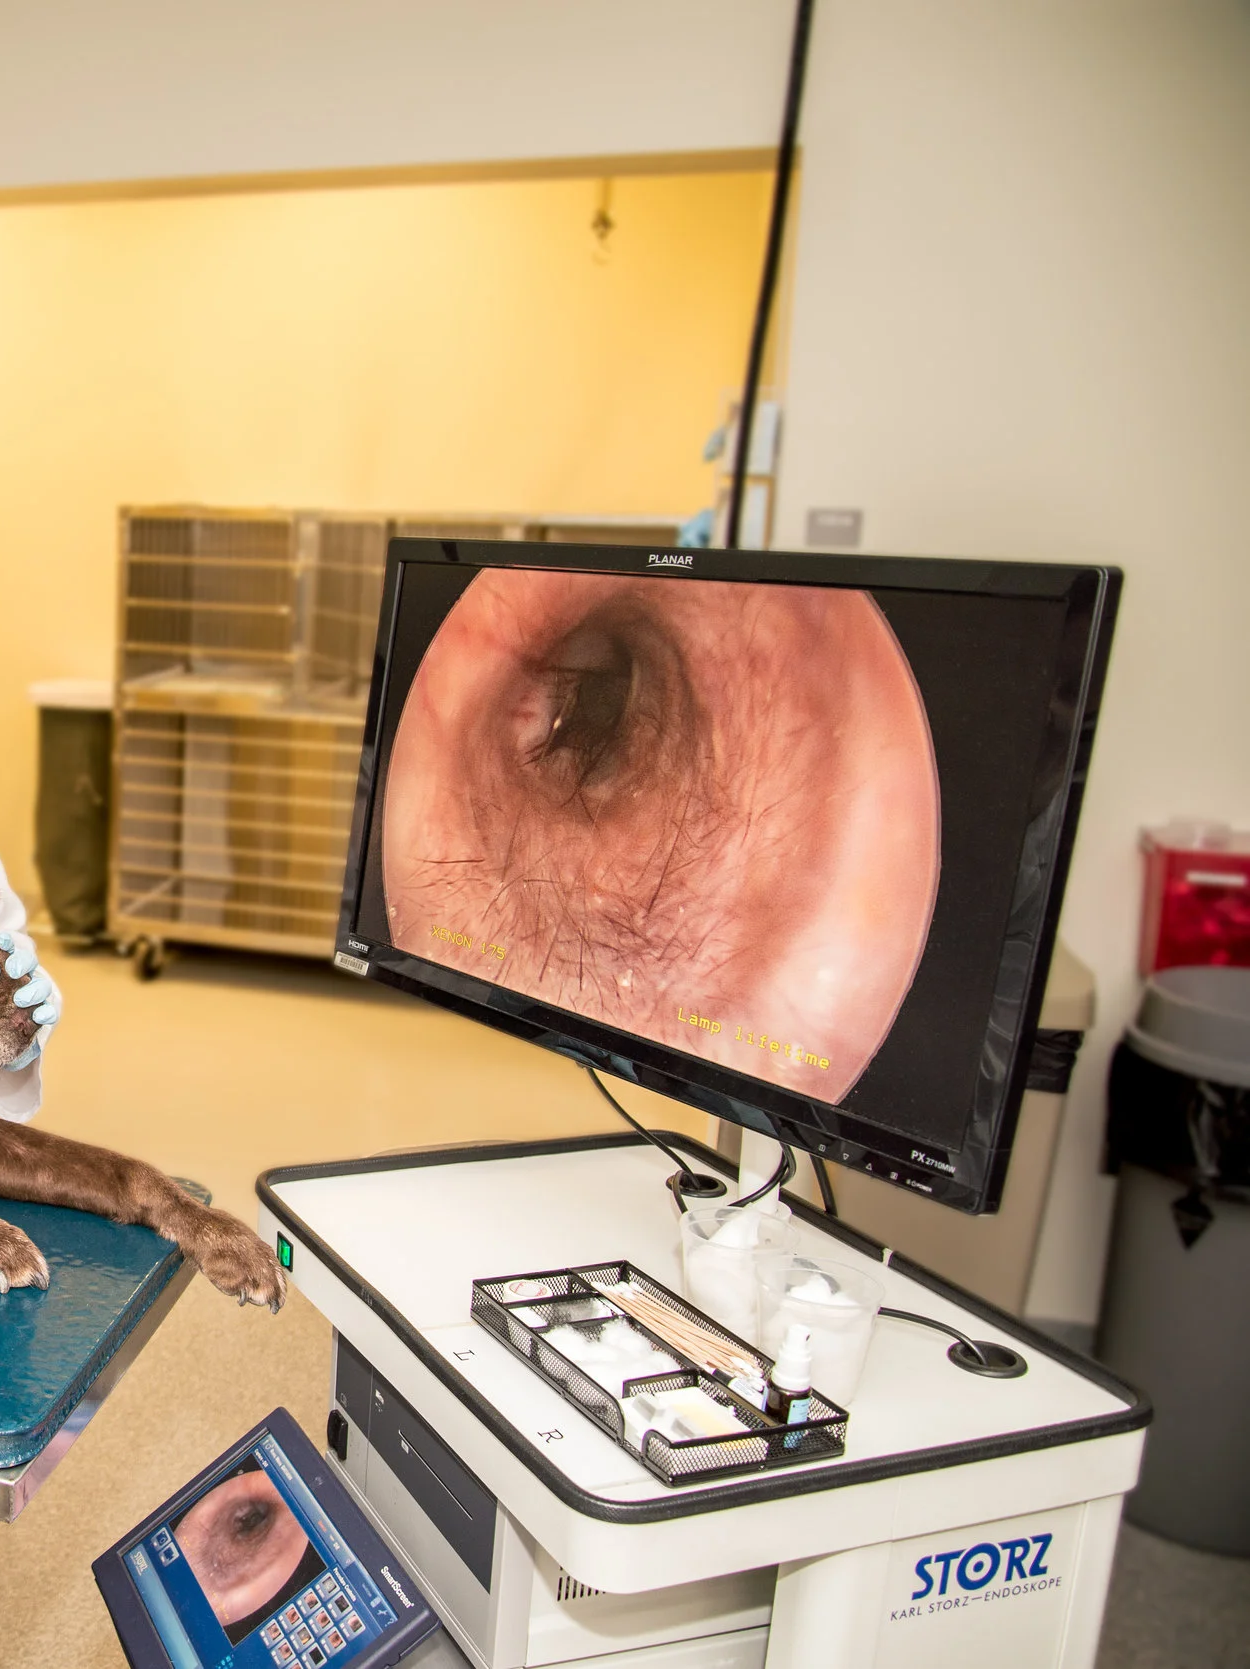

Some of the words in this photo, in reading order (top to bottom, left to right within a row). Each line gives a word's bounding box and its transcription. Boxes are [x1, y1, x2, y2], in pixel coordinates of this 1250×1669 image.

[648, 554, 693, 565] PLANAR
[348, 939, 370, 952] HDMI
[431, 925, 473, 950] XENON
[481, 942, 507, 961] 175
[677, 1007, 721, 1035] Lamp
[735, 1026, 830, 1070] lifetime
[453, 1349, 475, 1362] L
[537, 1428, 564, 1444] R
[911, 1533, 1053, 1601] STORZ
[890, 1606, 923, 1621] KARL
